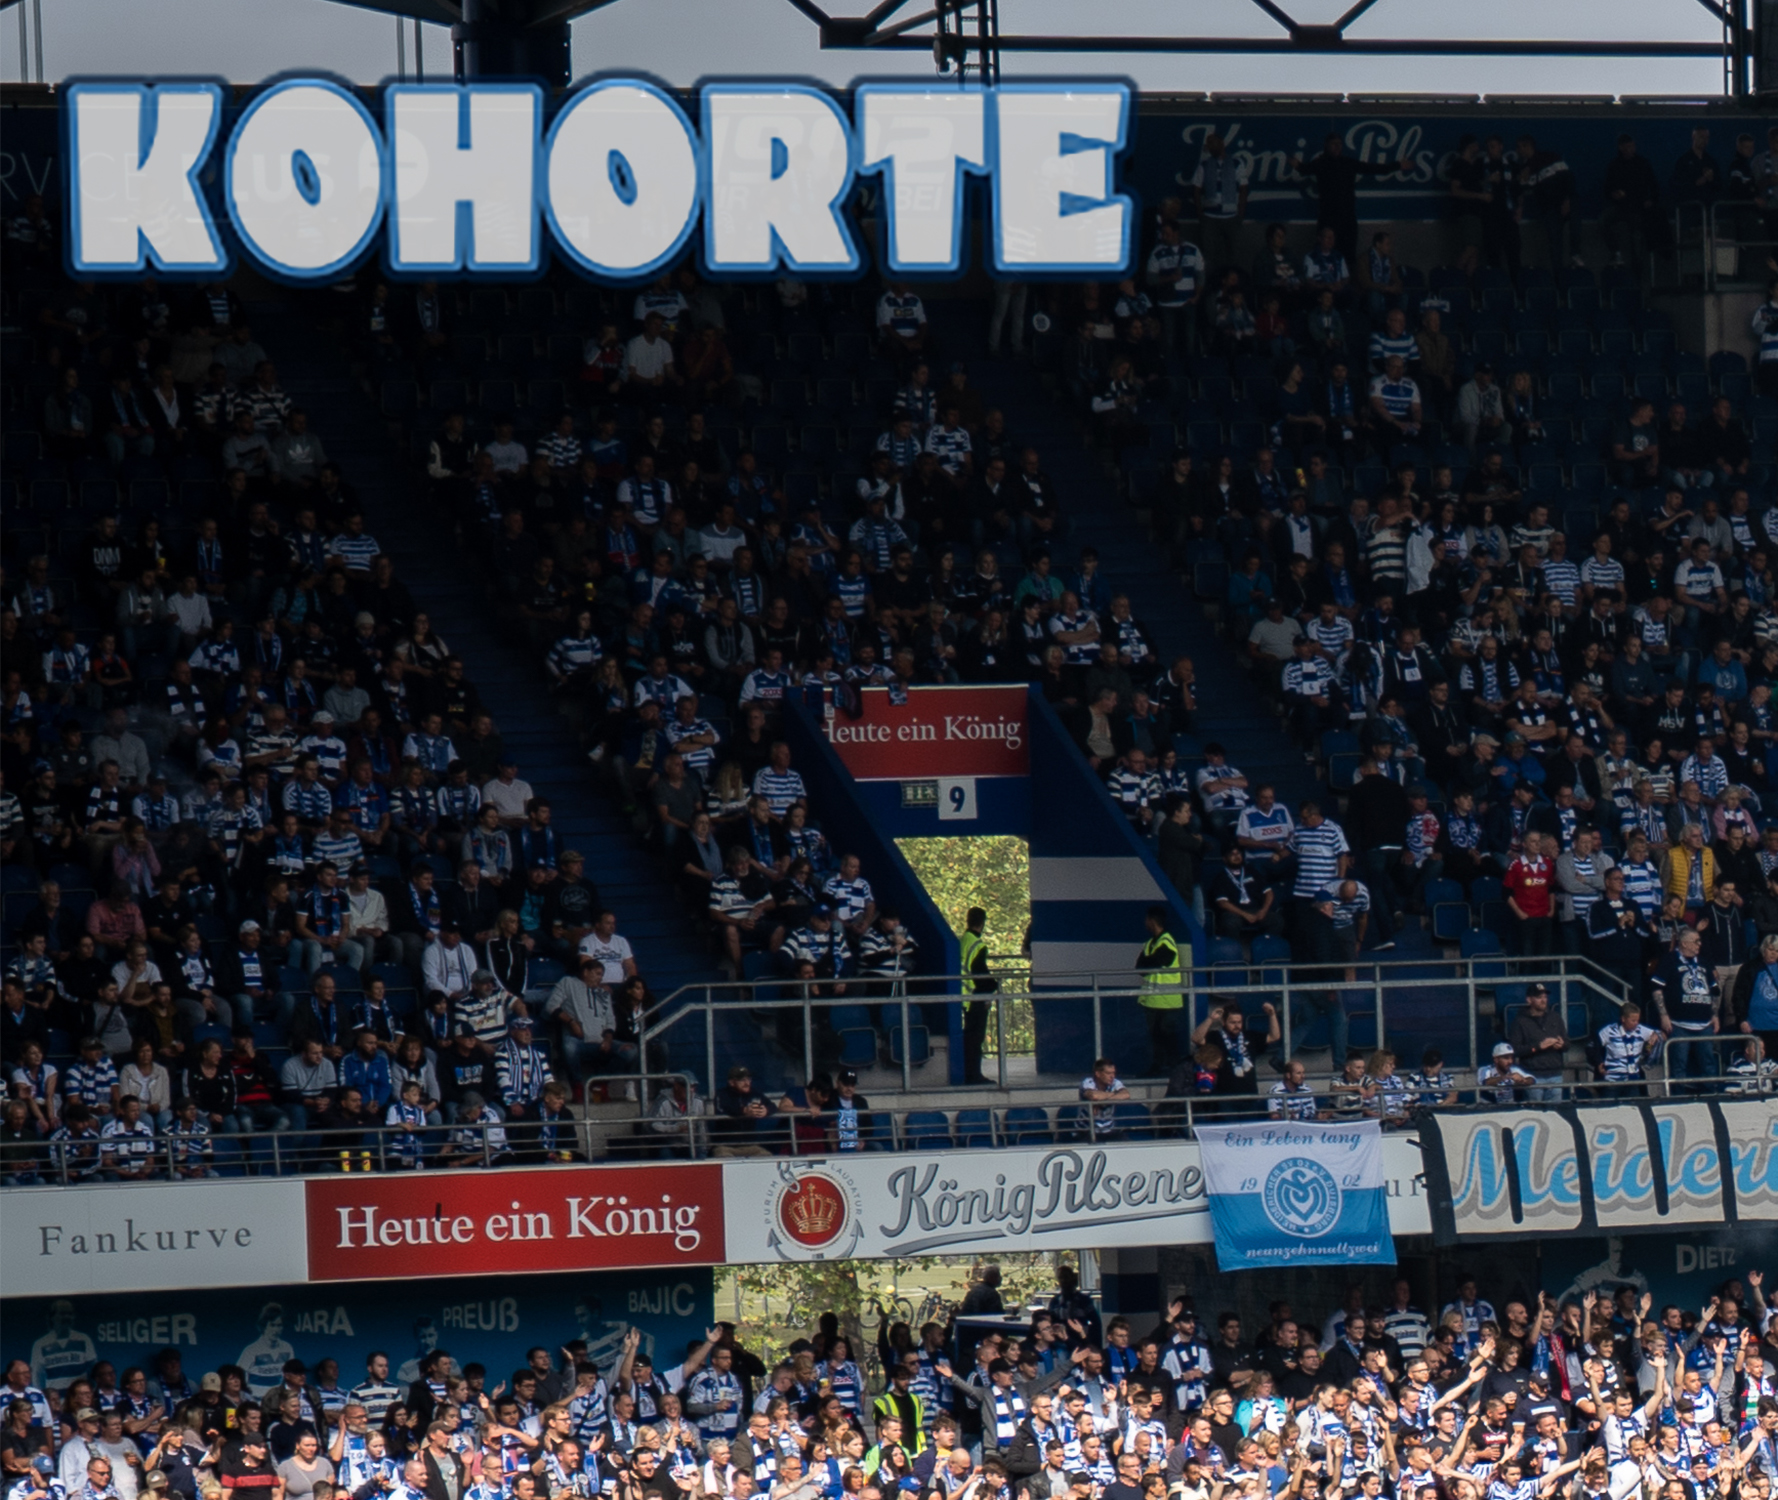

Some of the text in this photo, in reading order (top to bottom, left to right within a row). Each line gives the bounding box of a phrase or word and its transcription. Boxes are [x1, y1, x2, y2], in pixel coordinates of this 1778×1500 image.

[897, 715, 937, 742] ein
[943, 714, 1022, 750] König
[948, 784, 966, 813] 9
[1224, 1130, 1254, 1148] Ein
[880, 1149, 1208, 1237] König Pilsene
[38, 1217, 253, 1257] Fankurve
[336, 1194, 701, 1252] Heute ein König
[1675, 1242, 1736, 1275] DIETZ
[627, 1282, 696, 1317] BAJIC
[98, 1312, 198, 1346] SELIGER
[294, 1305, 355, 1338] JARA
